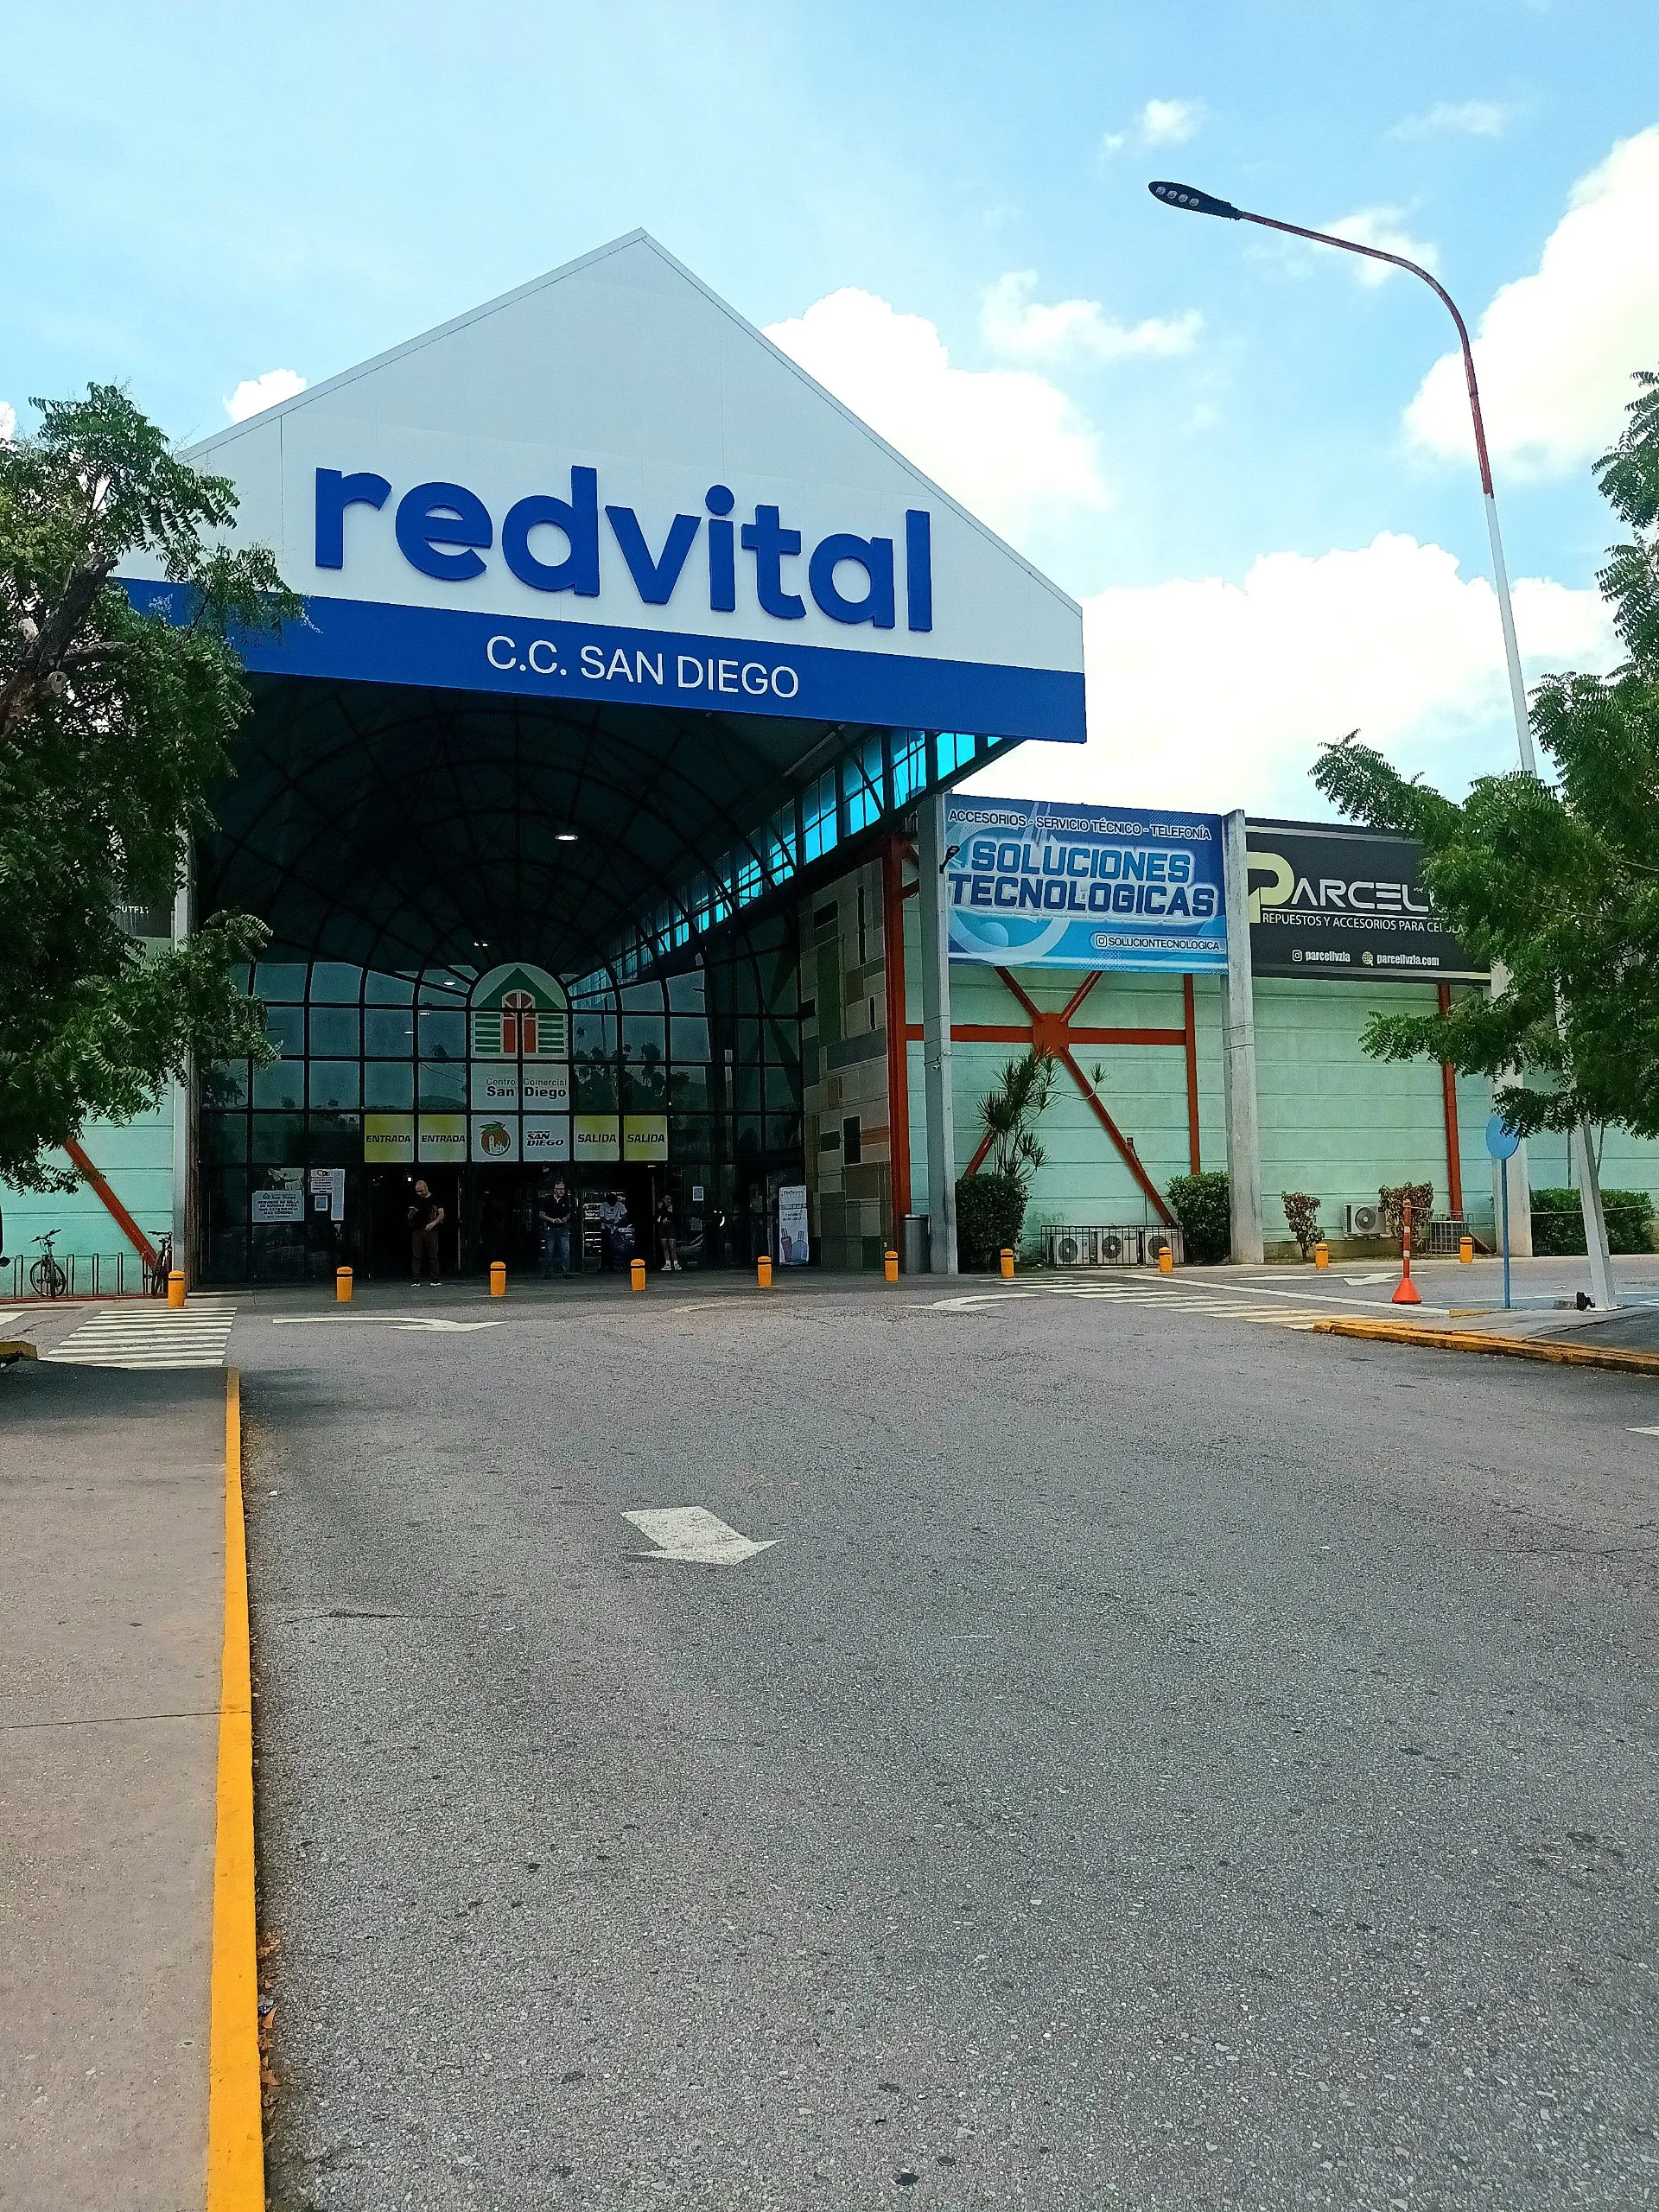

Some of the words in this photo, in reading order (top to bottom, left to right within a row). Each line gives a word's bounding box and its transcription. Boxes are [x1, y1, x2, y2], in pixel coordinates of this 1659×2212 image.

[315, 465, 933, 632] redvital
[486, 635, 567, 677] C.C.
[581, 645, 663, 685] SAN
[677, 654, 799, 698] DIEGO
[949, 810, 1027, 827] ACCESORIOS
[1036, 817, 1090, 832] SERVICIO
[1092, 818, 1141, 836] TÉCNICO
[1151, 824, 1211, 841] TELEFONÍA
[971, 840, 1191, 883] SOLUCIONES
[949, 873, 1215, 918] TECNOLOGICAS
[1247, 851, 1448, 923] PARCEL
[1262, 913, 1322, 927] REPUESTOS
[1323, 917, 1331, 927] Y
[1333, 918, 1397, 931] ACCESORIOS
[1399, 920, 1425, 932] PARA
[1108, 937, 1225, 952] SOLUCIONTECNOLOGICA_
[486, 1077, 516, 1086] Centro
[523, 1077, 567, 1086] Comercial
[486, 1086, 515, 1097] San
[524, 1086, 567, 1100] Diego
[365, 1135, 411, 1143] ENTRADA
[421, 1135, 466, 1143] ENTRADA
[577, 1134, 617, 1143] SALIDA
[626, 1134, 665, 1143] SALIDA
